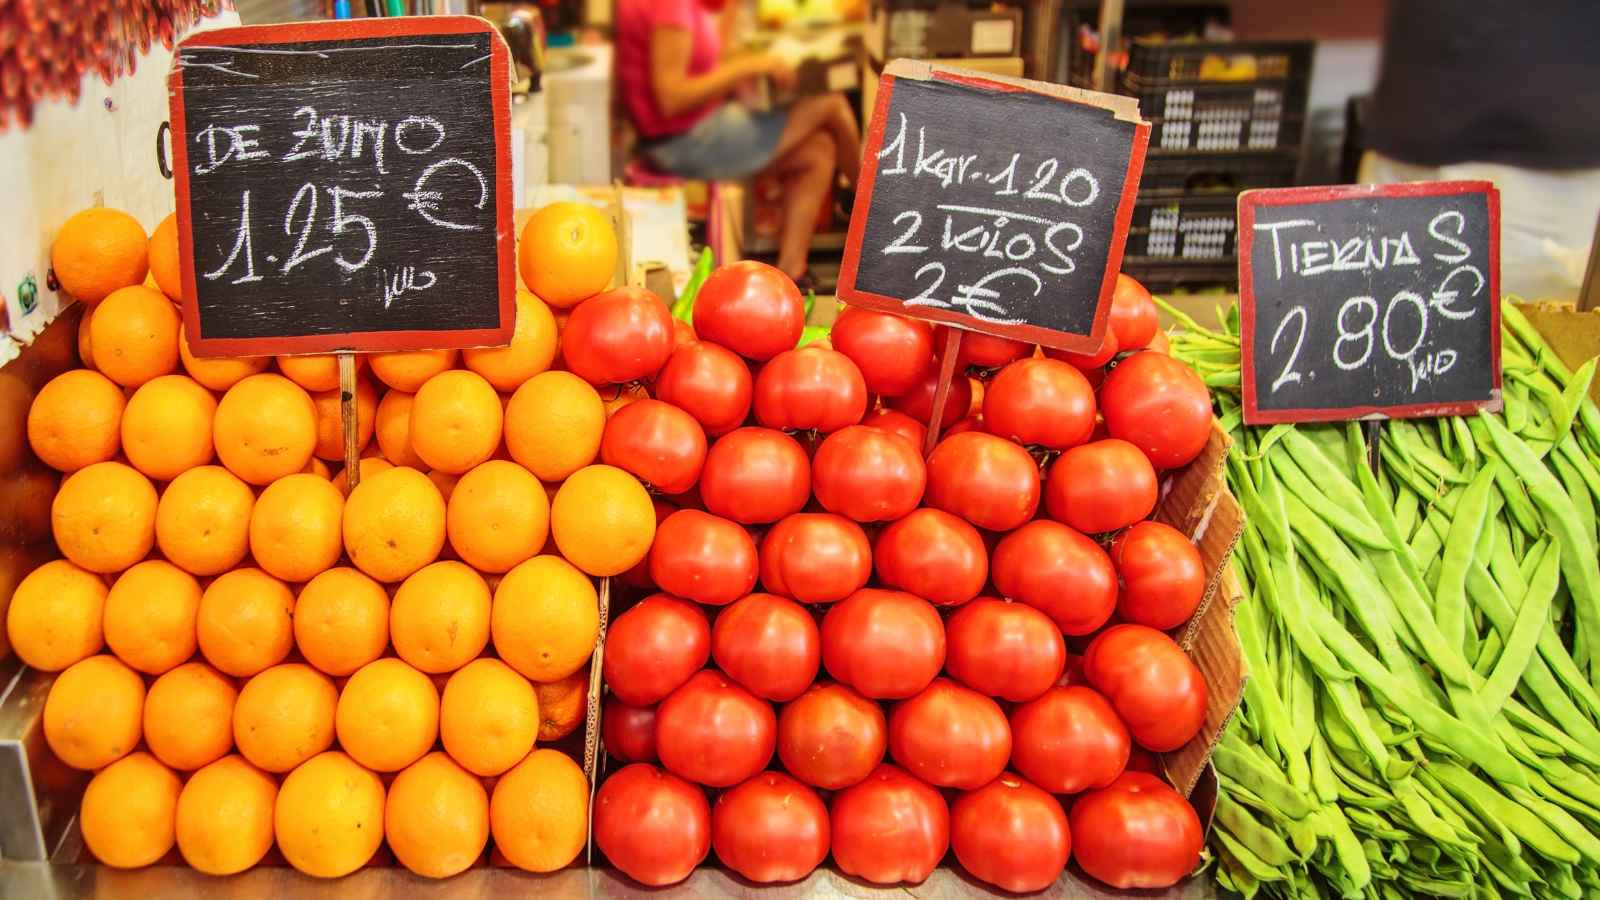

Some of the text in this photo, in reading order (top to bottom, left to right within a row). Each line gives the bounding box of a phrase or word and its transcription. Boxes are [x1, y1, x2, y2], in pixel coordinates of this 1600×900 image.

[195, 106, 446, 175] DE ZUMO
[881, 210, 930, 256] 2
